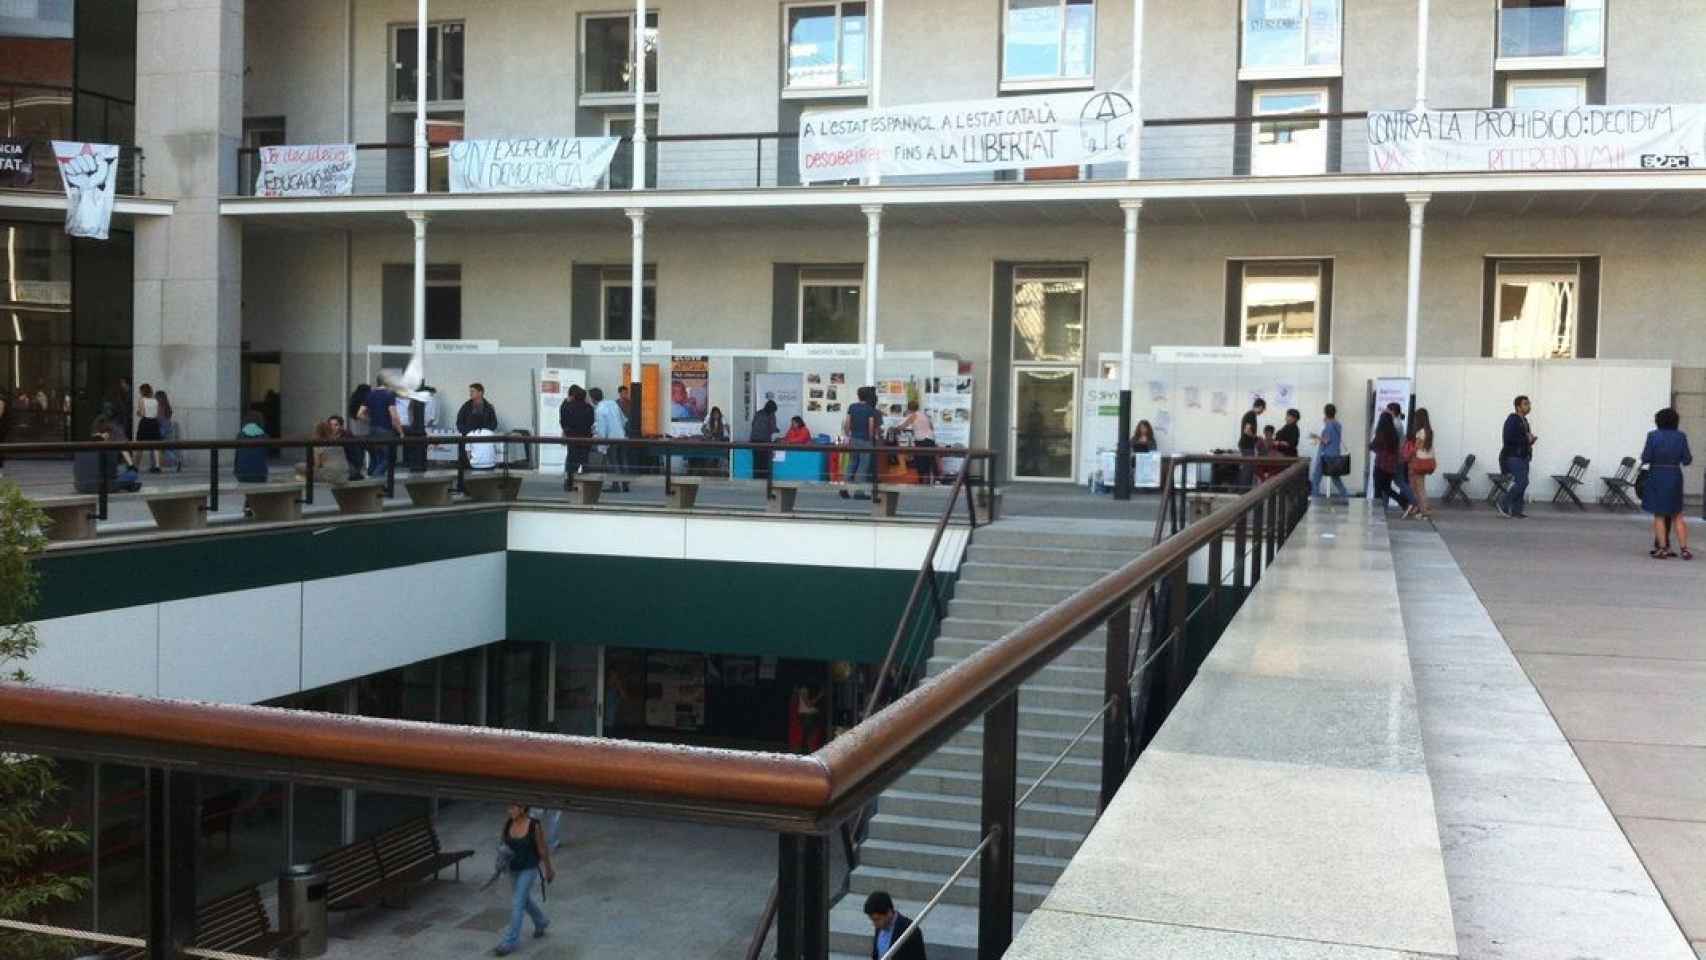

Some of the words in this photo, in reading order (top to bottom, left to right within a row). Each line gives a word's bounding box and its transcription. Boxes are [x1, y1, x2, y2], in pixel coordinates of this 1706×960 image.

[803, 122, 816, 137] A
[942, 113, 952, 129] A
[1367, 111, 1433, 145] CONTRA
[1439, 112, 1462, 140] LA
[895, 145, 921, 161] FINS
[926, 146, 938, 161] A
[941, 143, 958, 160] LA
[962, 129, 1059, 164] LLIBERTAT
